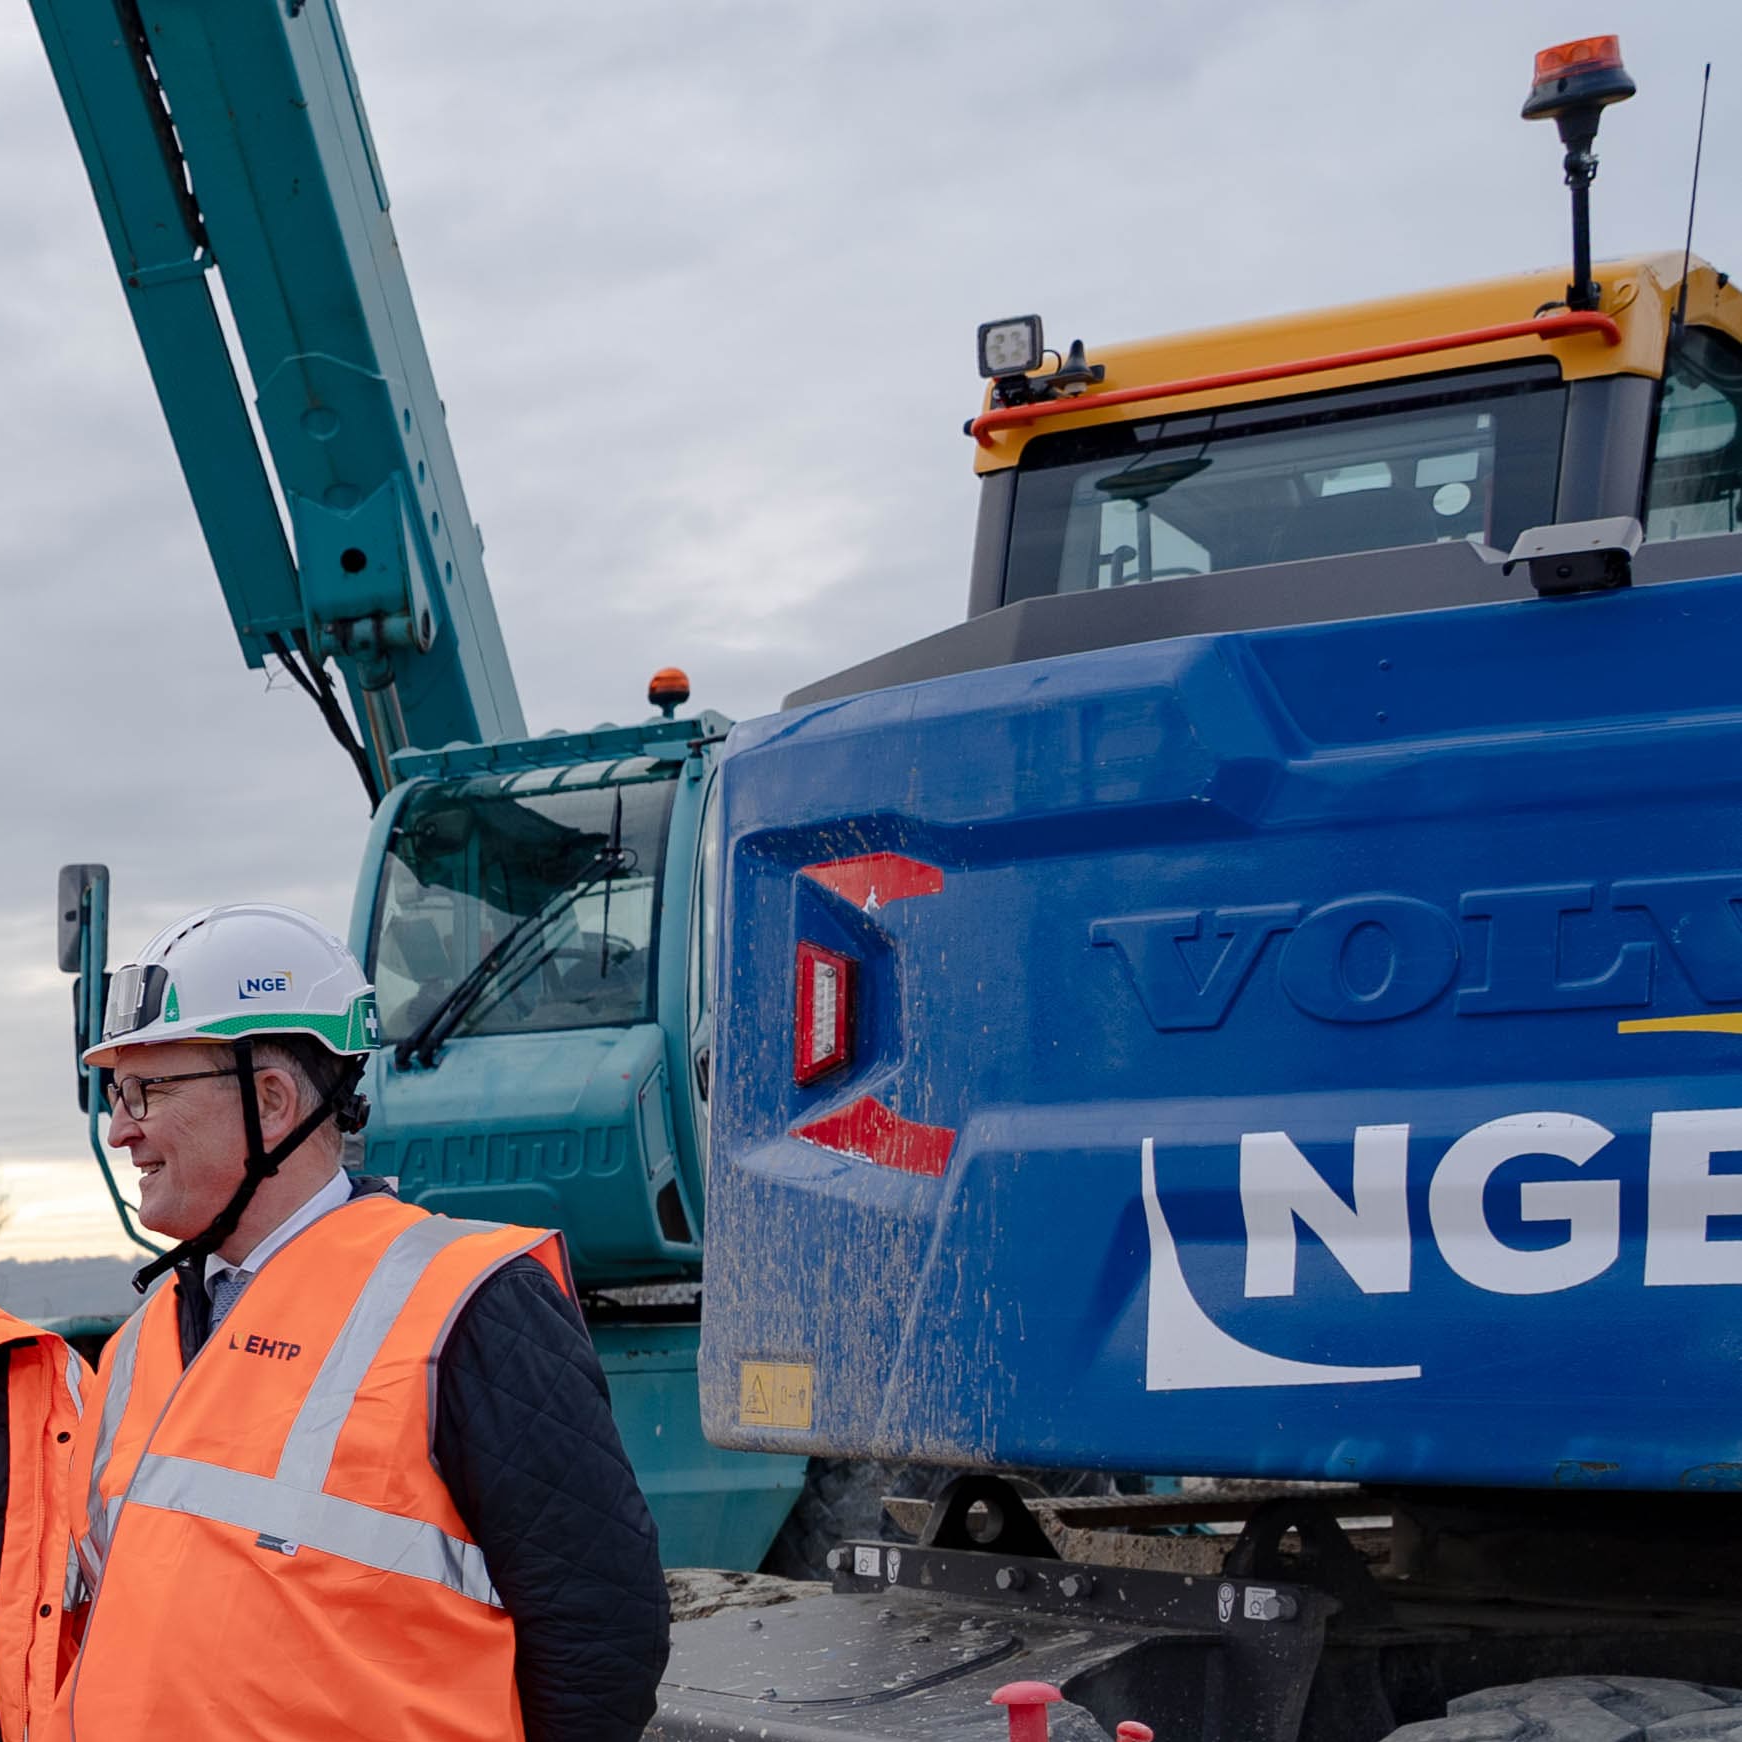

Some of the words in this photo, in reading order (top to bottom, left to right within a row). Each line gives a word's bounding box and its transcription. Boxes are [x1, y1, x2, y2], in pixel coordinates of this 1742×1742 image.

[247, 978, 286, 992] NGE
[1239, 1110, 1742, 1299] NGE
[244, 1334, 301, 1361] EHTP
